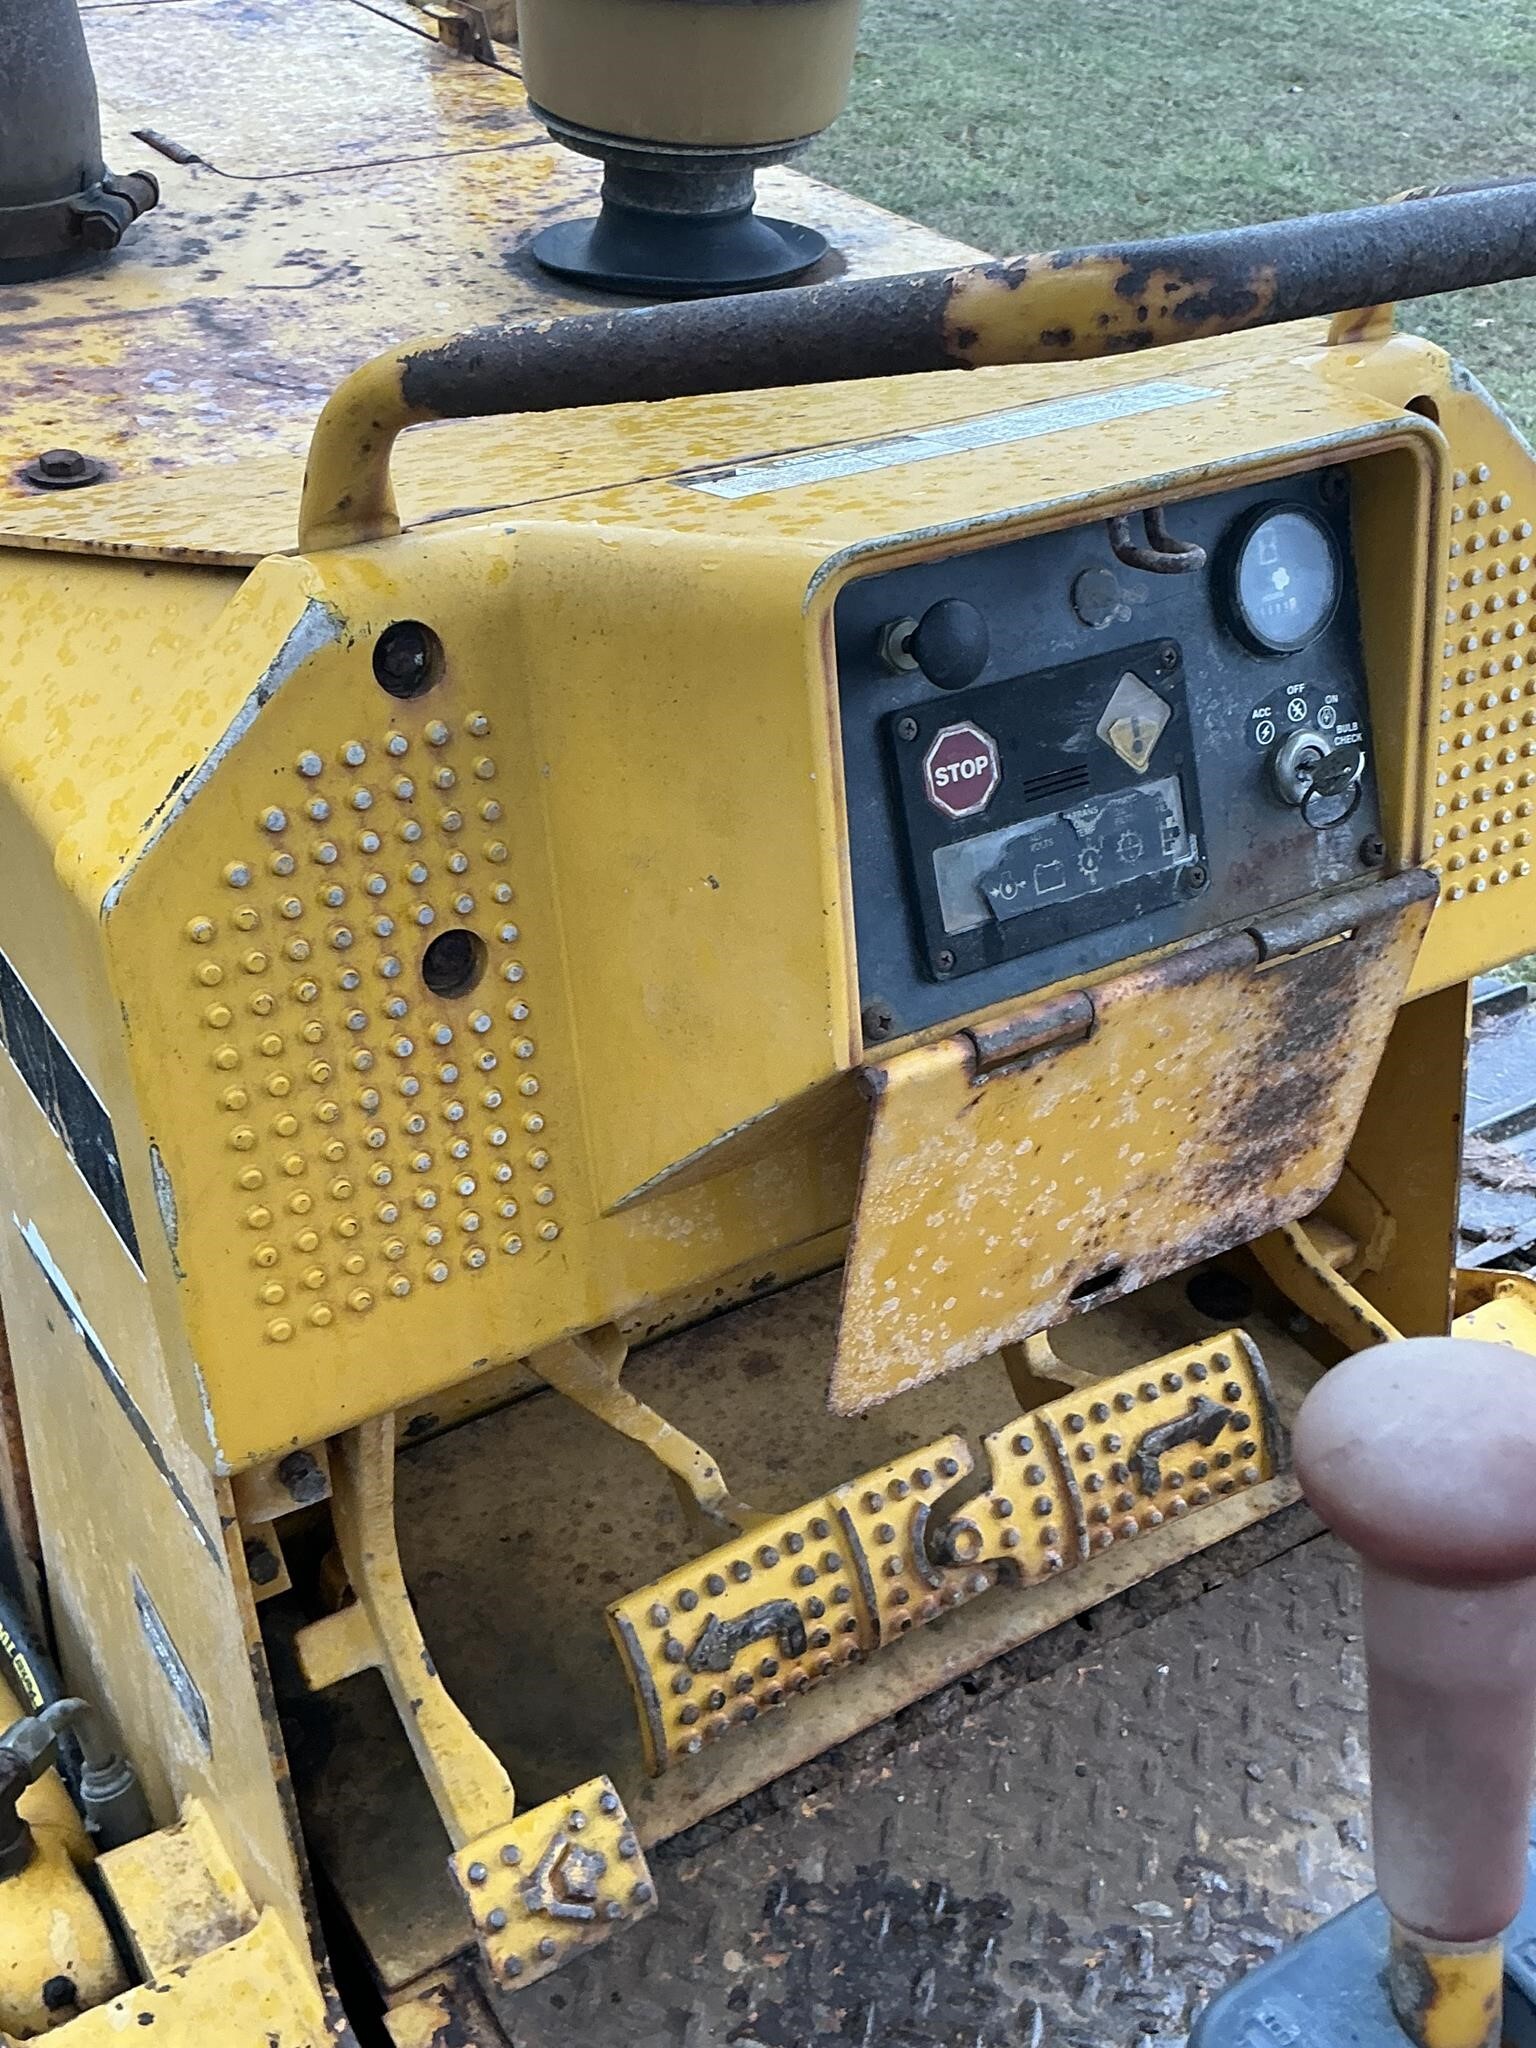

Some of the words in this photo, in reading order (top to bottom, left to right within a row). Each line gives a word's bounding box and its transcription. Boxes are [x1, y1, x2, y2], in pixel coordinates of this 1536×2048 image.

[1286, 683, 1305, 694] OFF
[1325, 695, 1338, 704] ON
[1252, 707, 1272, 719] ACC
[1336, 722, 1358, 734] BULB
[1334, 733, 1363, 746] CHECK
[934, 755, 988, 787] STOP
